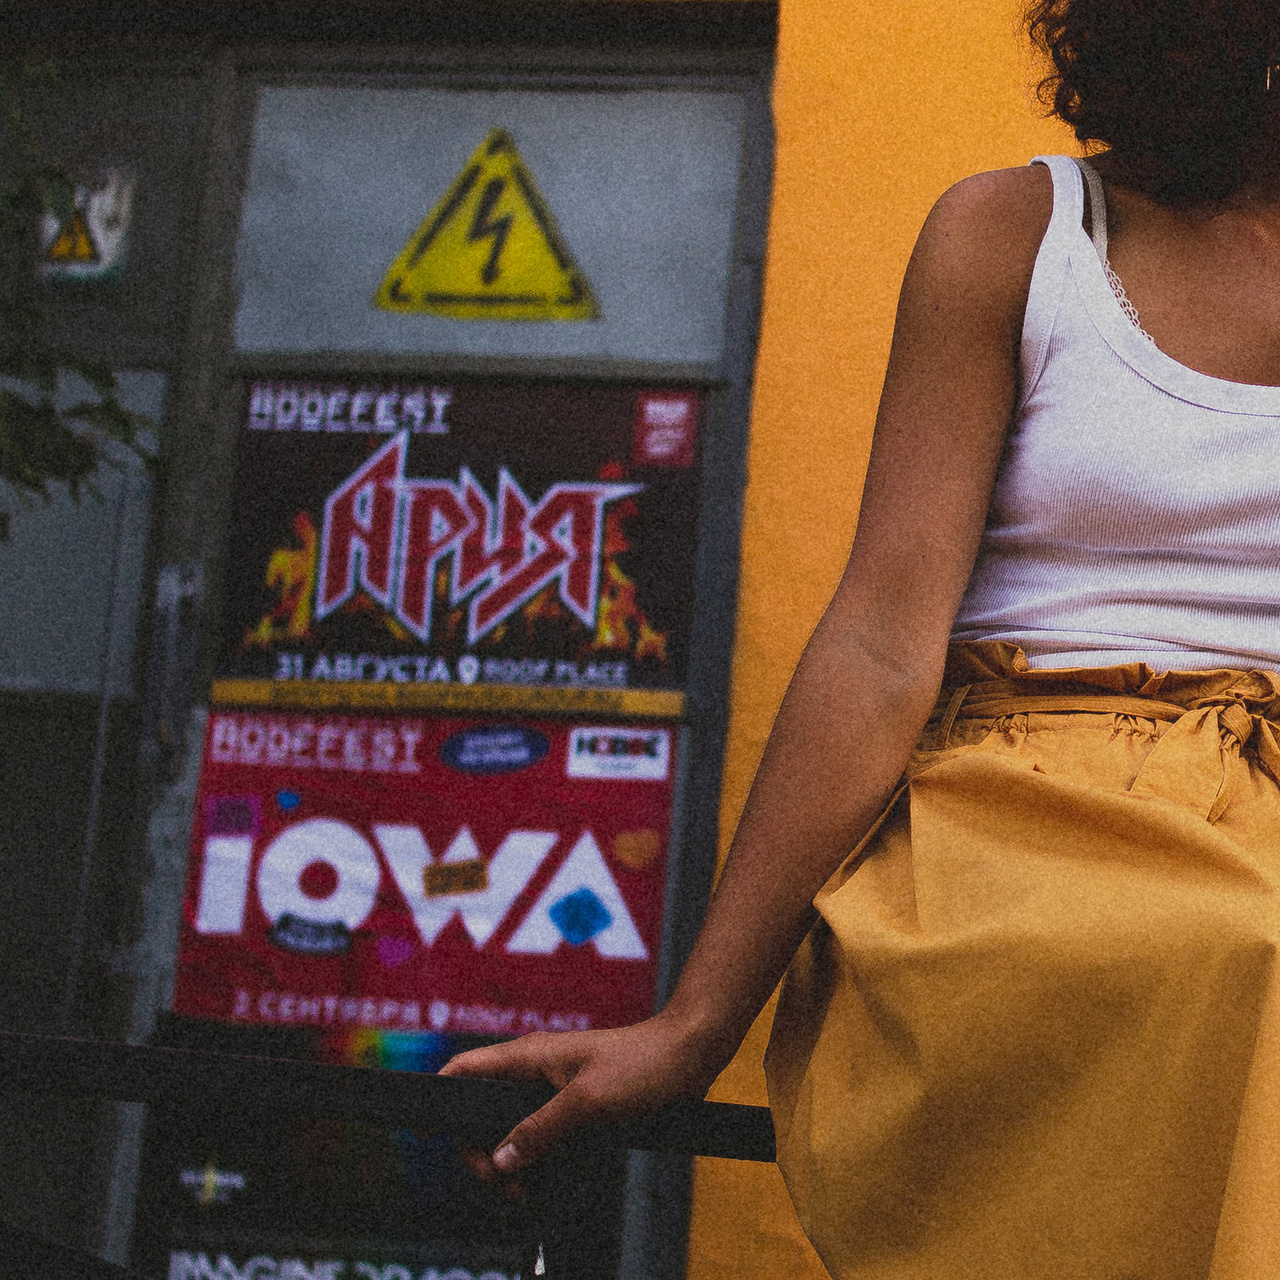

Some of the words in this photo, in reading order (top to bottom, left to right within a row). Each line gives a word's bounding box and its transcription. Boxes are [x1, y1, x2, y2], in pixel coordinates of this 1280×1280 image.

[316, 427, 650, 646] АРИЯ
[310, 654, 450, 683] АВГУСТА
[196, 817, 649, 960] IOWA
